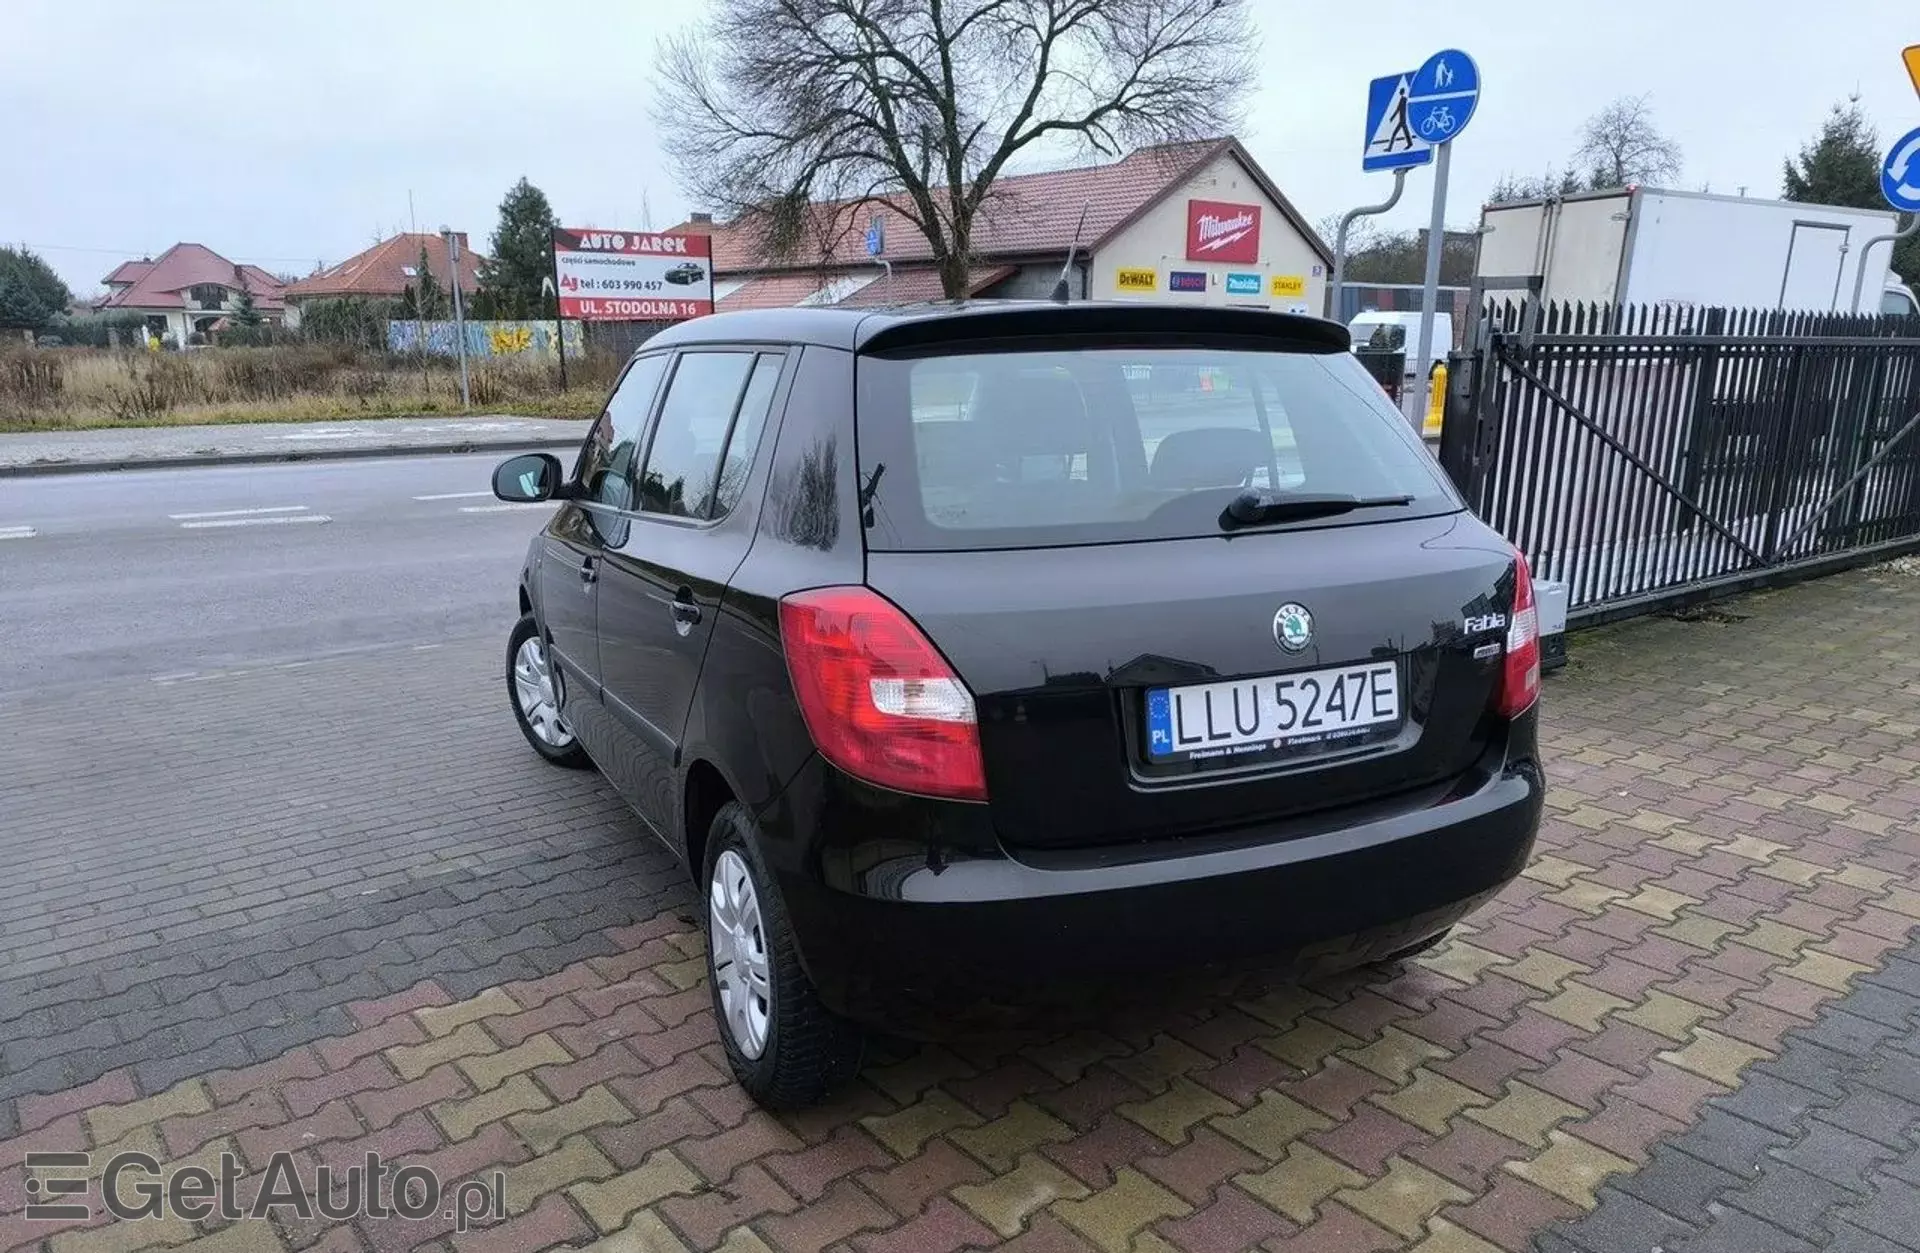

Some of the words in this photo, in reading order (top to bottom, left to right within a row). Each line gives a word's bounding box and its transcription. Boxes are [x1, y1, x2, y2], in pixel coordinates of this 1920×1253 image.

[580, 233, 625, 250] AUTO
[584, 257, 636, 267] samochodowe
[602, 280, 621, 290] 603
[623, 280, 642, 290] 990
[644, 280, 663, 291] 457
[580, 300, 602, 313] UL.
[605, 301, 677, 315] STODOLNA
[681, 302, 696, 315] 16
[1464, 612, 1506, 634] Fabia
[1176, 685, 1260, 745] LLU
[1275, 668, 1393, 731] 5247E
[1152, 729, 1170, 744] PL
